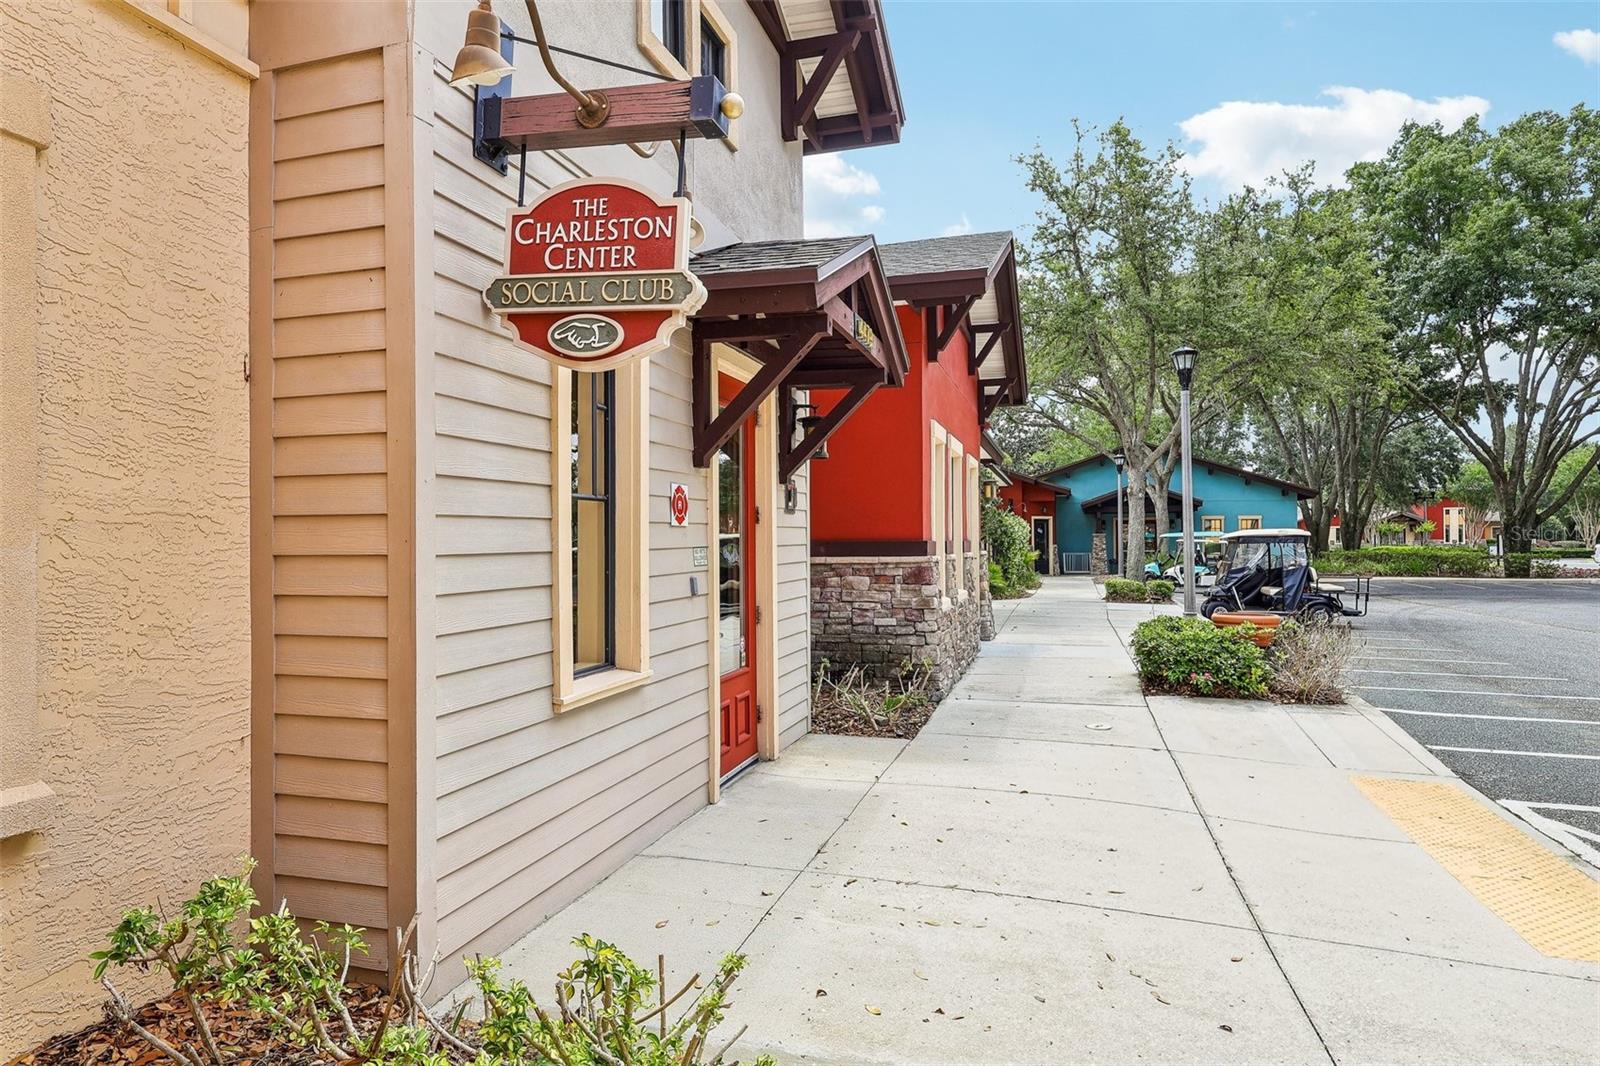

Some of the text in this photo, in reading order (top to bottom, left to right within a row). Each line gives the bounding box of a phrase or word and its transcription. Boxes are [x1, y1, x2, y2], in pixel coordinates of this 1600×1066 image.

[572, 197, 609, 217] THE
[514, 216, 673, 245] CHARLESTON
[544, 244, 637, 270] CENTER
[501, 278, 675, 305] SOCIAL CLUB
